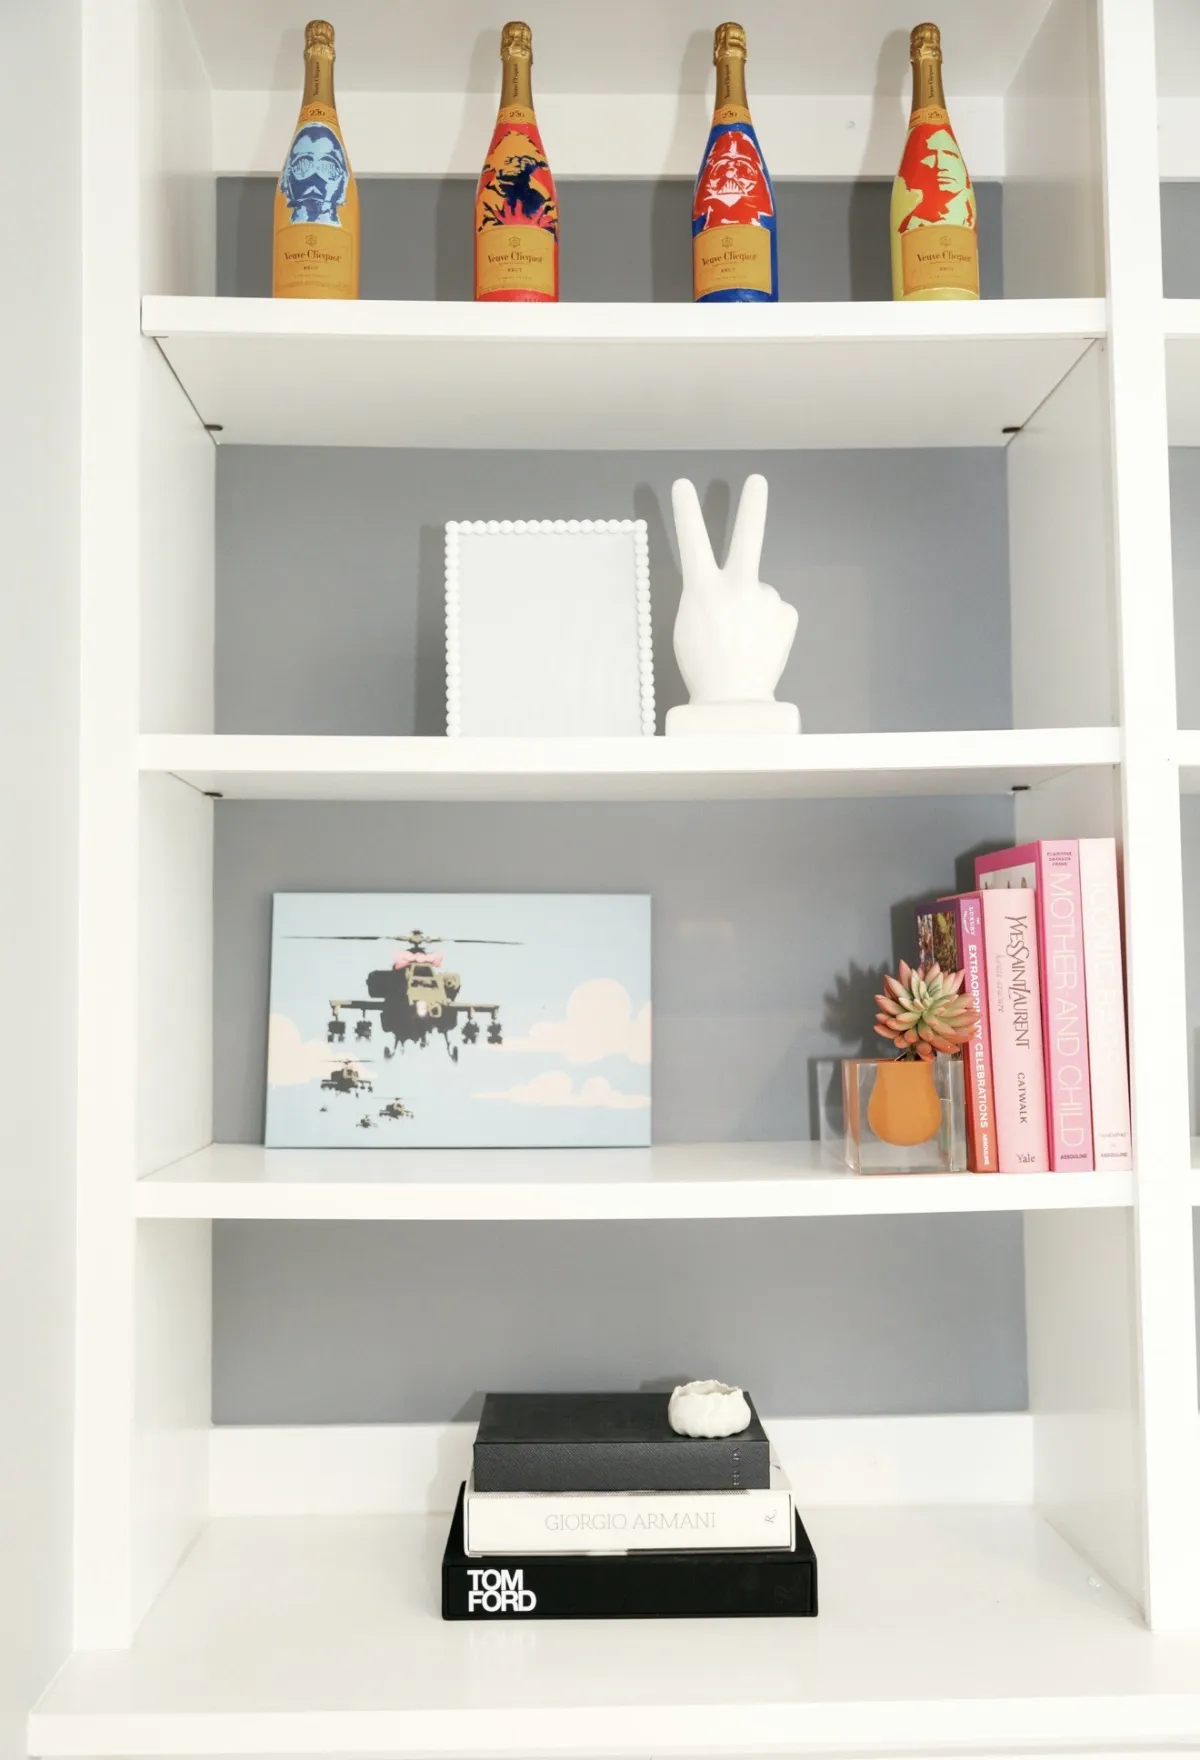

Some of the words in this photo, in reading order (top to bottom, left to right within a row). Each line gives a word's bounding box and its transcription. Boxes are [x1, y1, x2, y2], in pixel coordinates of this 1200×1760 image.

[284, 251, 305, 261] Veuve
[307, 249, 342, 264] Clicquot
[487, 255, 509, 264] Veuve
[511, 251, 543, 263] Clicquot
[702, 256, 722, 266] Veuve
[723, 251, 758, 262] Clicquot
[917, 253, 940, 262] Veuve
[942, 251, 971, 262] Clicquot
[1050, 873, 1078, 990] MOTHER
[968, 944, 982, 1040] EXTRAORDIRY
[1054, 997, 1080, 1056] AND
[974, 1043, 988, 1129] CELEBRATIONS
[1017, 1072, 1028, 1124] CATWALK
[1057, 1065, 1085, 1147] CHILD
[1016, 1153, 1036, 1163] Yale
[544, 1513, 627, 1531] GIORGIO
[632, 1512, 716, 1530] ARMANI
[466, 1569, 524, 1591] TOM
[468, 1590, 537, 1612] FORD
